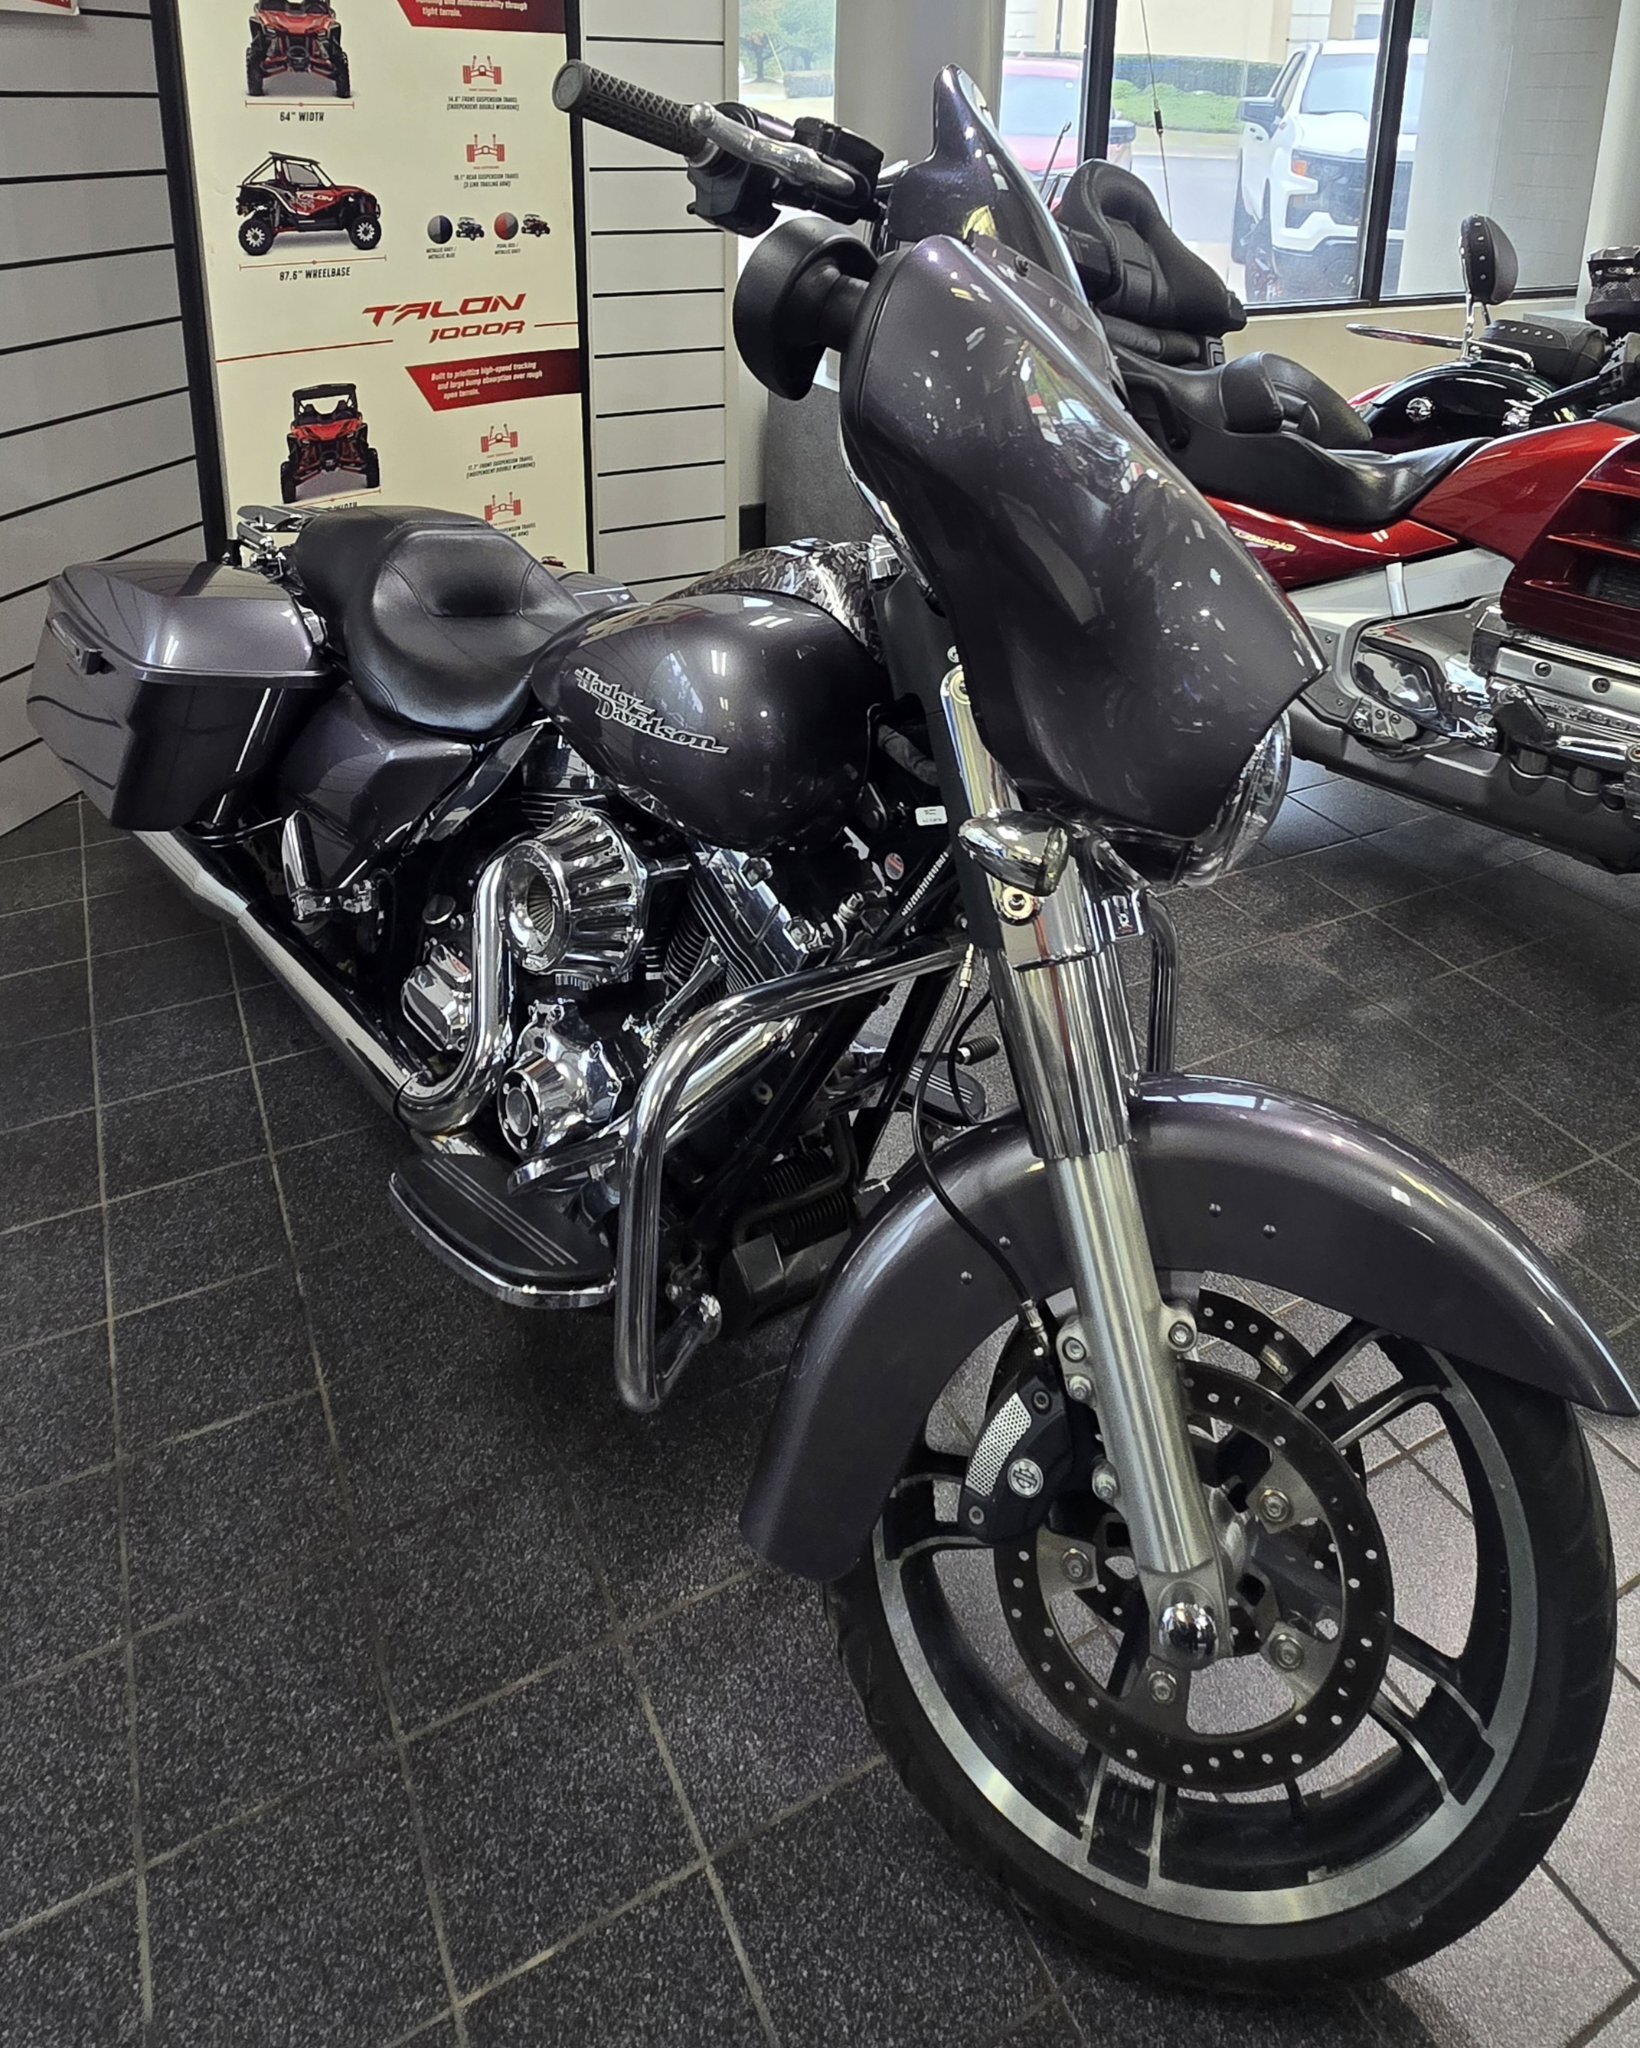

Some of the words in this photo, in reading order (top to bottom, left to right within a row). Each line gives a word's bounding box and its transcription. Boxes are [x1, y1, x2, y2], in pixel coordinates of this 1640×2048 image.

[280, 112, 296, 121] 64"
[299, 112, 325, 121] WIDTH
[280, 270, 303, 281] 87.6"
[305, 267, 351, 279] WHEELBASE
[362, 293, 527, 327] TALON
[429, 320, 525, 344] 1000R
[595, 698, 730, 754] Davidson
